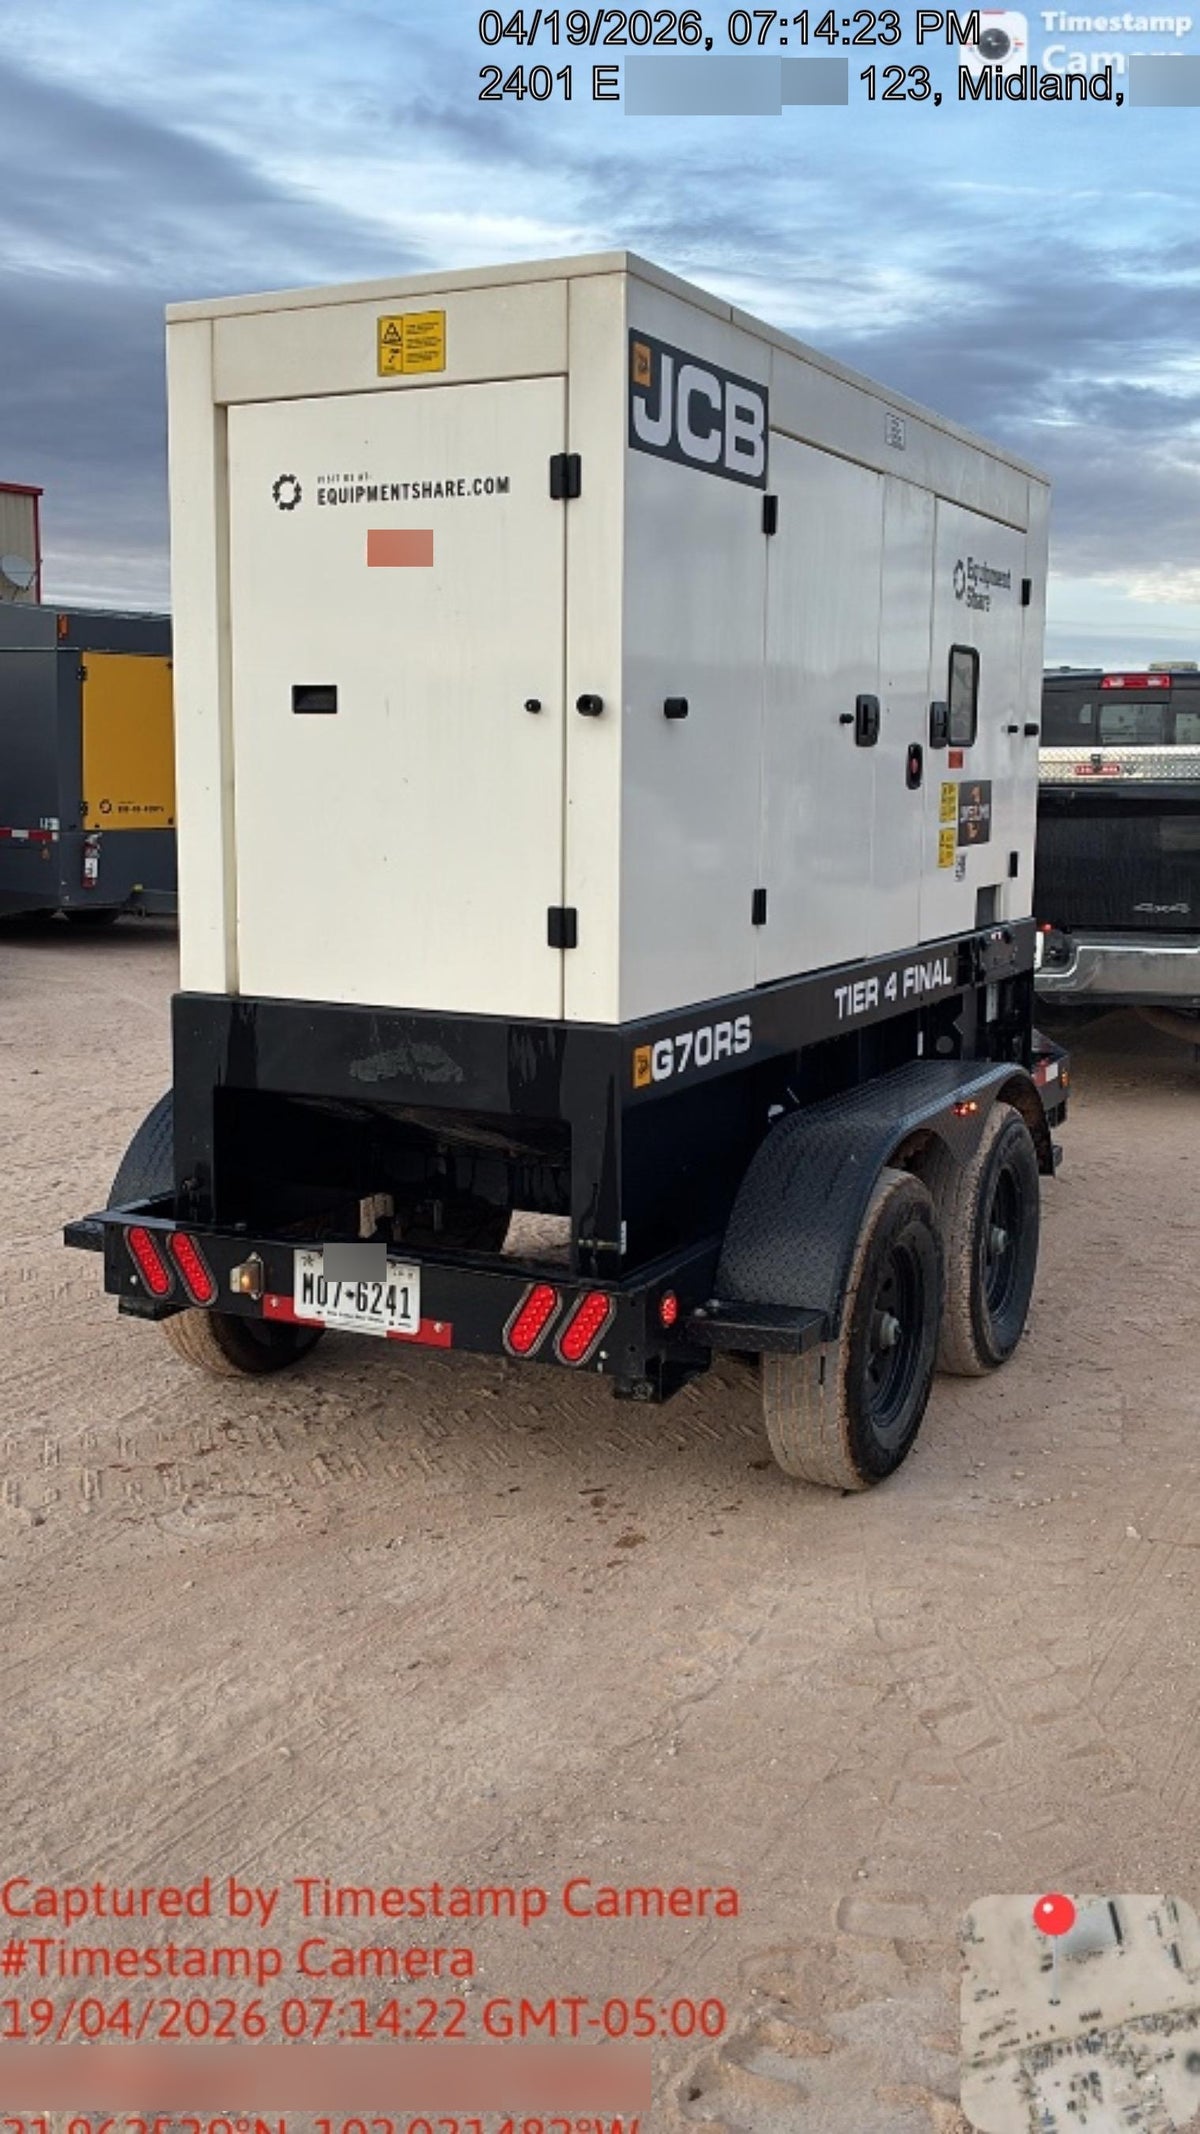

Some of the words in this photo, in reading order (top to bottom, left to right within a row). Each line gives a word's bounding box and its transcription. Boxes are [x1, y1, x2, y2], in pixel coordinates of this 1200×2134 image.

[632, 352, 765, 478] JCB
[317, 476, 510, 506] EQUIPMENTSHARE.COM
[834, 976, 879, 1020] TIER
[884, 971, 898, 1002] 4
[903, 957, 952, 999] FINAL
[651, 1014, 752, 1083] G70RS
